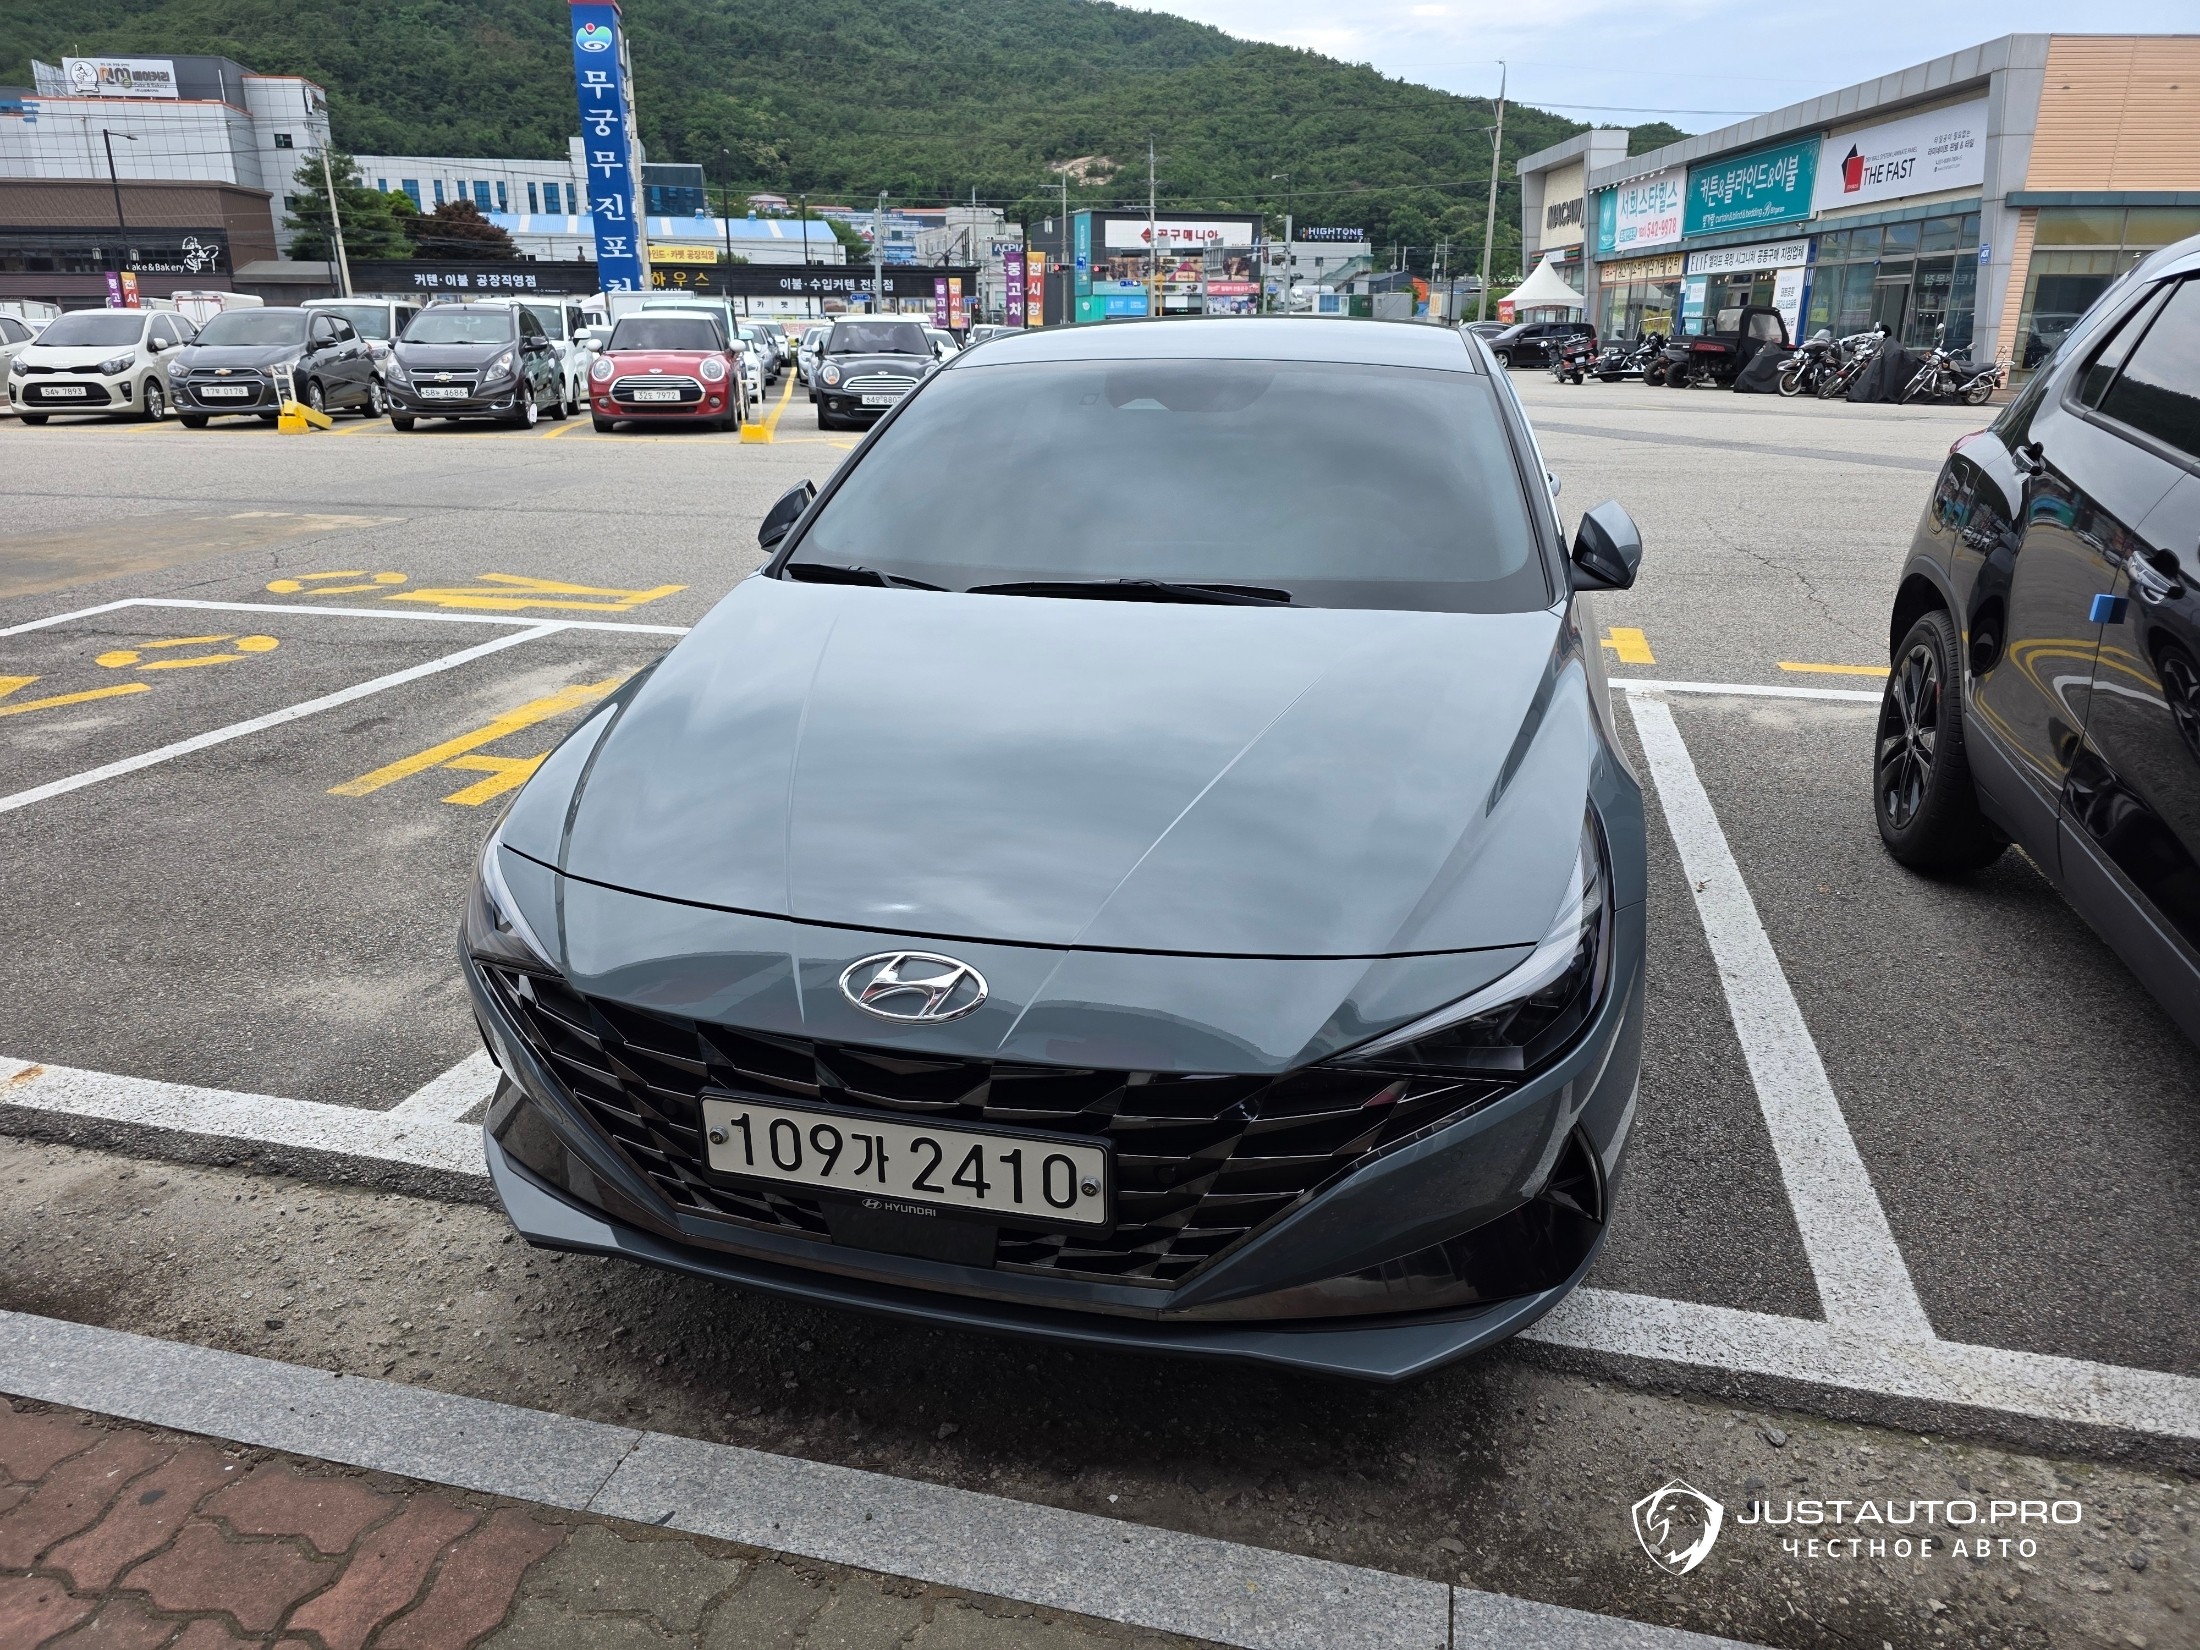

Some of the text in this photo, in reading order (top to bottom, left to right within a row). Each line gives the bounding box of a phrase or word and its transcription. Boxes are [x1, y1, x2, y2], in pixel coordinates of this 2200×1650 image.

[1701, 155, 1799, 207] 커튼&블라인드&이불
[1863, 158, 1916, 186] THE FAST
[1620, 181, 1678, 219] 서희스타힐스
[1308, 227, 1364, 236] HIGHTONE
[1690, 253, 1708, 271] ELIF
[414, 274, 537, 287] 커텐·이불 공장직영점
[780, 278, 855, 291] 이불·수입커텐
[1007, 262, 1022, 316] 중고차
[1028, 262, 1042, 316] 전시장
[656, 391, 676, 400] 7972
[730, 1112, 1078, 1209] 109가 2410
[884, 1202, 936, 1217] HYUNDAI
